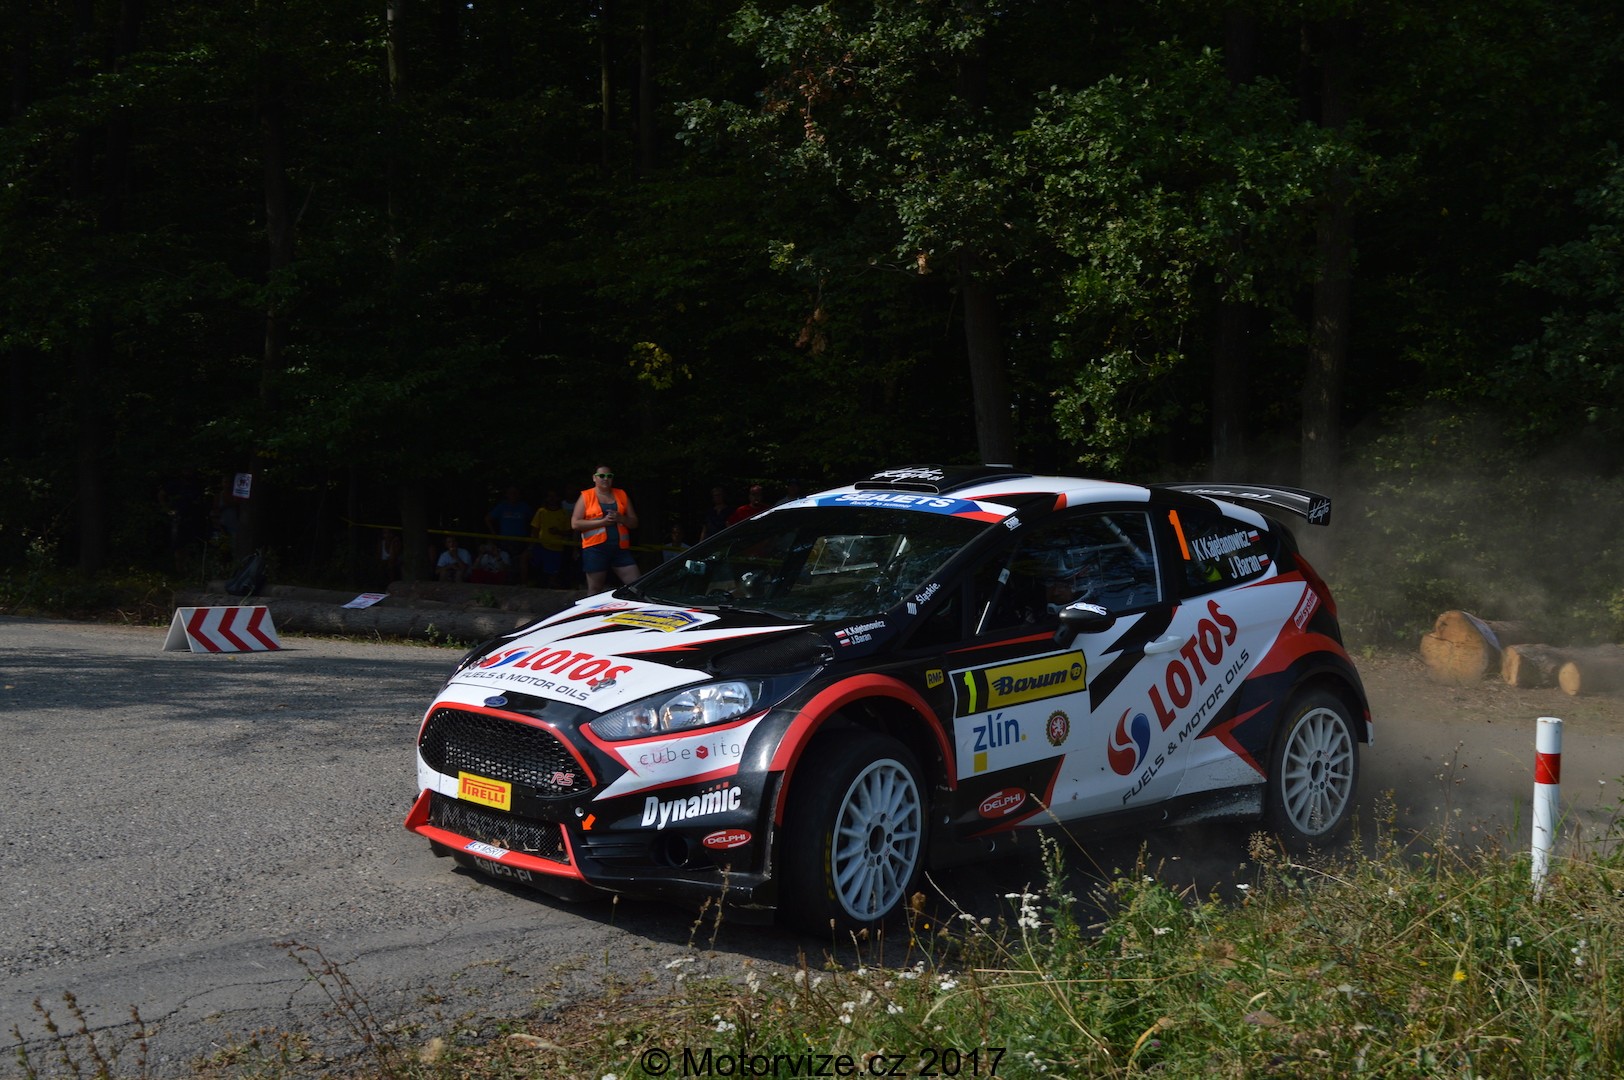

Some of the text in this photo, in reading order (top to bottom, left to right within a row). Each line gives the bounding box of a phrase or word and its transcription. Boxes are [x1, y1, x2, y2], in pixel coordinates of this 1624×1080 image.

[835, 493, 956, 508] SEAJETS
[1168, 509, 1191, 560] 1
[1192, 528, 1251, 562] K Kajetanowicz
[1228, 555, 1262, 579] J Baran
[513, 647, 633, 687] LOTOS
[927, 673, 944, 685] RMF
[1148, 599, 1237, 732] LOTOS
[460, 671, 591, 701] FUELS & MOTOR OILS
[964, 670, 978, 713] 1
[992, 669, 1068, 696] Barum
[1122, 649, 1250, 805] FUELS & MOTOR OILS
[639, 742, 741, 765] cube itg
[462, 777, 506, 804] PIRELLI
[551, 772, 575, 786] RS
[641, 783, 741, 830] Dynamic
[983, 793, 1021, 813] DELPHI
[707, 834, 746, 845] DELPHI
